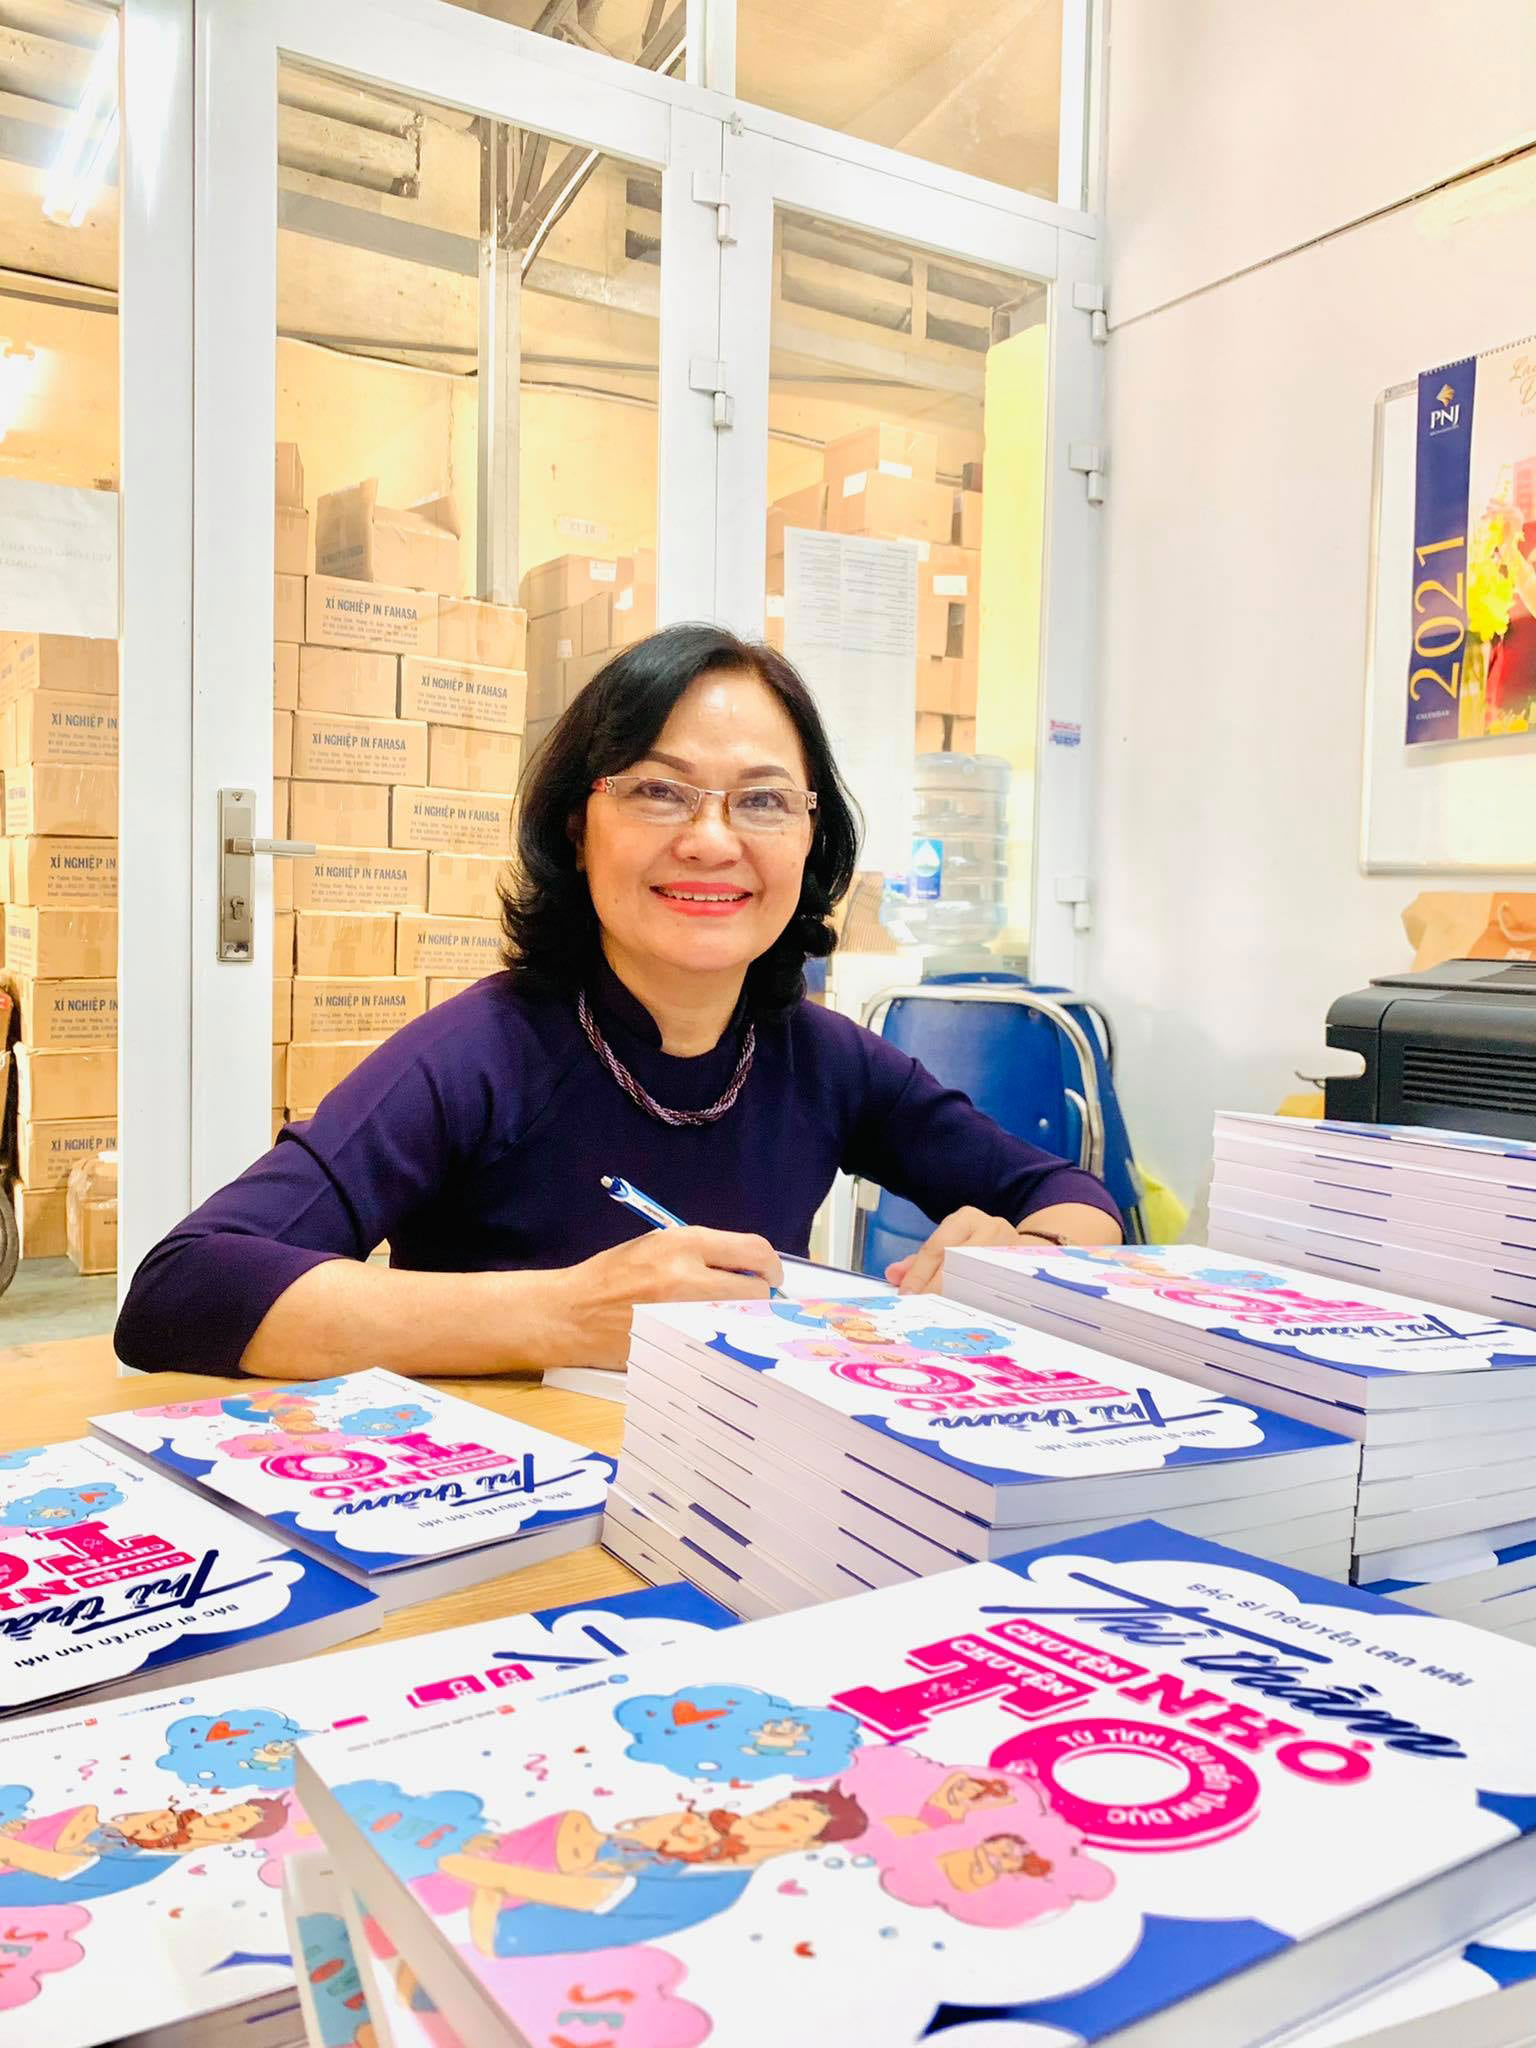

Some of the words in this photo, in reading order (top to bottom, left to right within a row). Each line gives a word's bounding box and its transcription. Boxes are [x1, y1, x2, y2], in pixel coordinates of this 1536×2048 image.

[1430, 404, 1460, 429] PNJ
[373, 604, 382, 617] IN
[385, 605, 418, 621] FAHASA
[1409, 536, 1465, 701] 2021
[466, 682, 474, 694] IN
[476, 684, 508, 699] FAHASA
[360, 737, 370, 748] IN
[372, 738, 406, 751] FAHASA
[457, 808, 467, 819] IN
[469, 809, 500, 823] FAHASA
[105, 857, 117, 869] IN
[362, 867, 371, 879] IN
[374, 868, 407, 881] FAHASA
[461, 936, 470, 946] IN
[361, 995, 371, 1006] IN
[373, 995, 406, 1006] FAHASA
[106, 1137, 116, 1149] IN
[0, 1595, 105, 1641] thầ
[948, 1637, 1078, 1698] CHUYỆN
[1001, 1621, 1133, 1679] CHUYỆN
[1116, 1673, 1376, 1786] NHỎ
